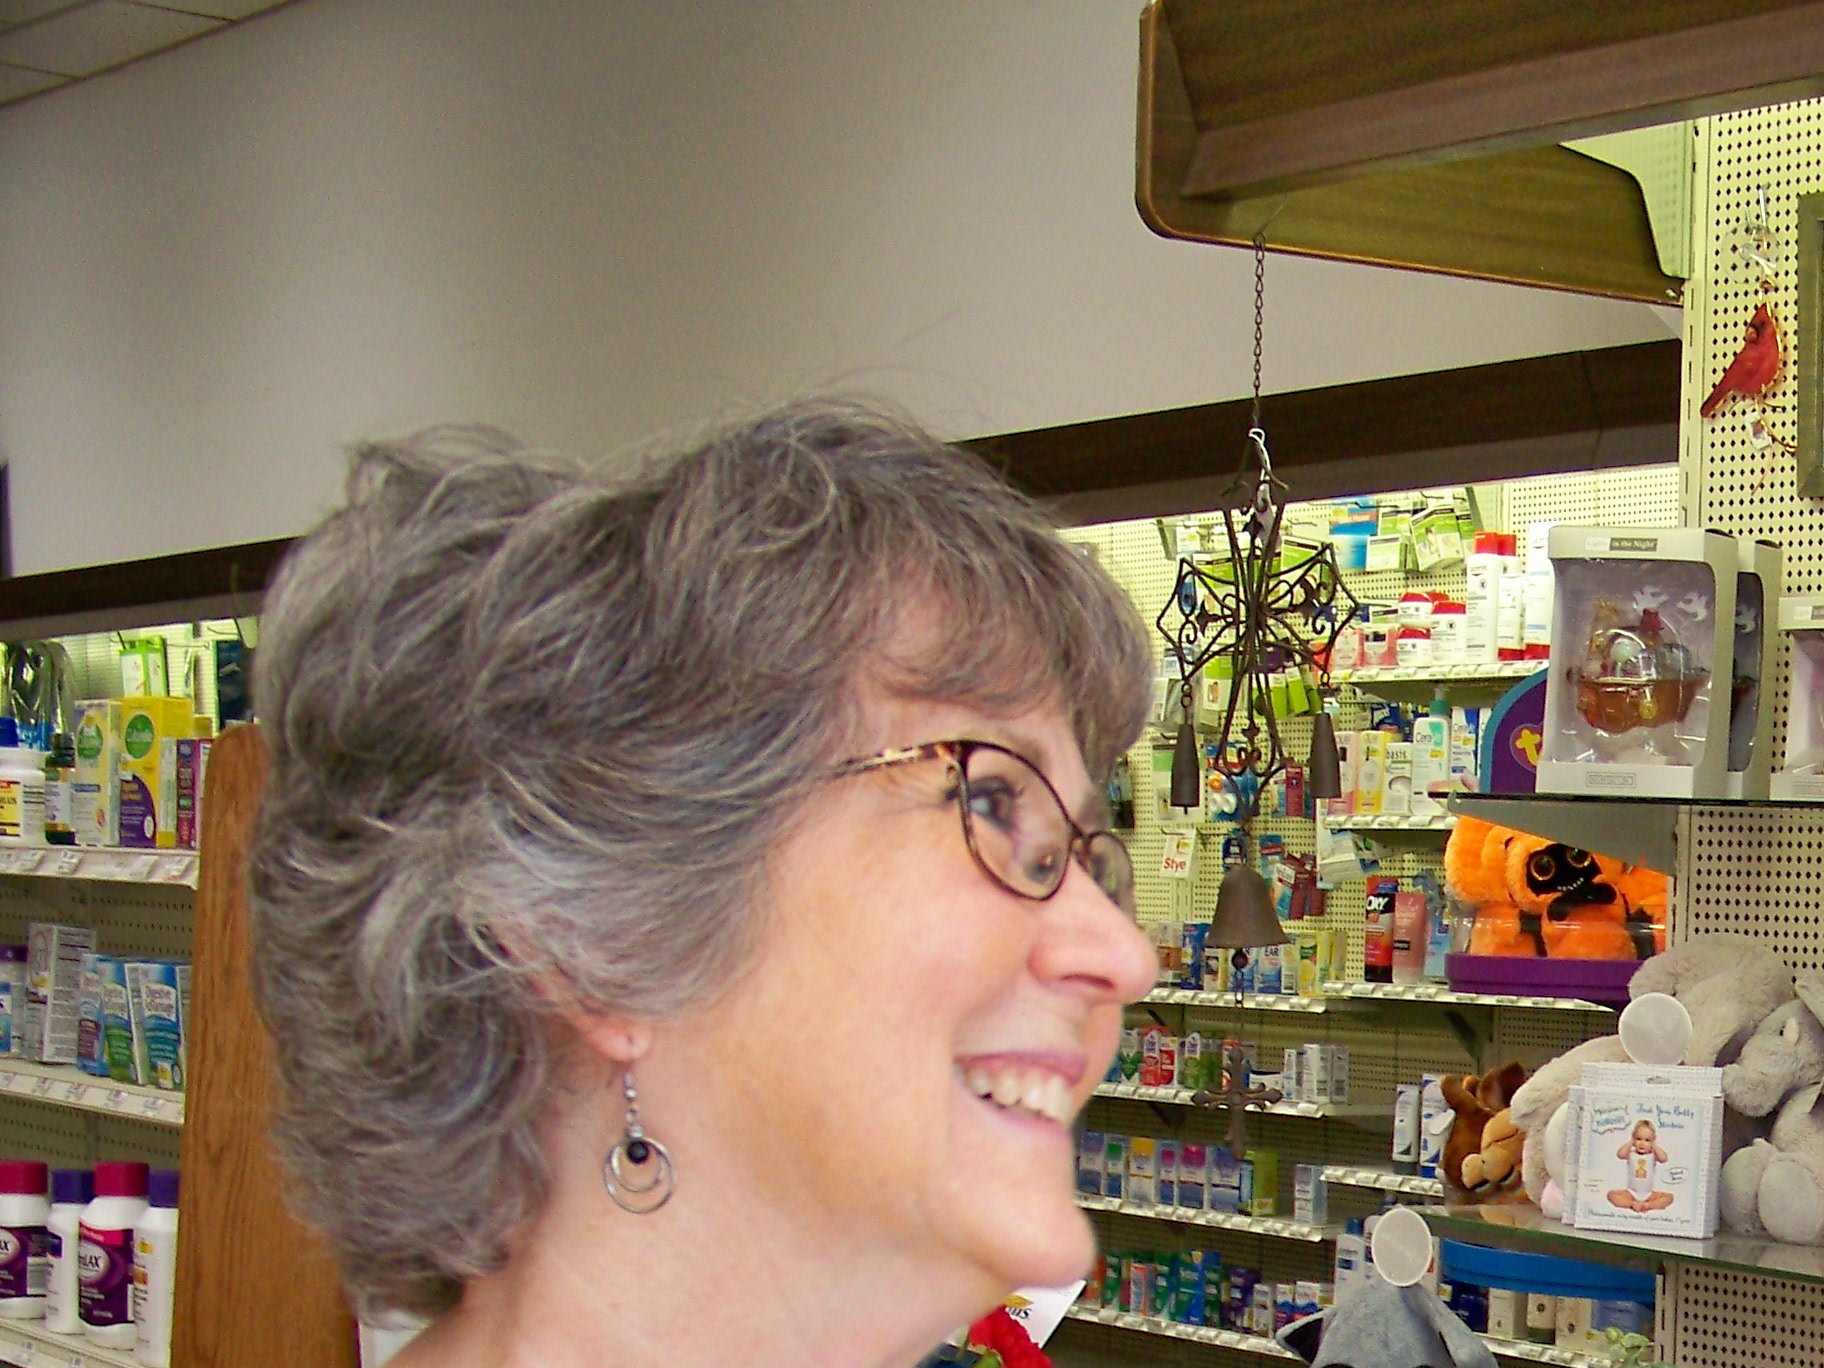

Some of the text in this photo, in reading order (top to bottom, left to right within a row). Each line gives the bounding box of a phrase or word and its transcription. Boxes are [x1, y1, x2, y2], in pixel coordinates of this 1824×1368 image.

[1163, 857, 1187, 872] Stye
[1367, 895, 1390, 911] OXY
[1264, 947, 1279, 957] EAR
